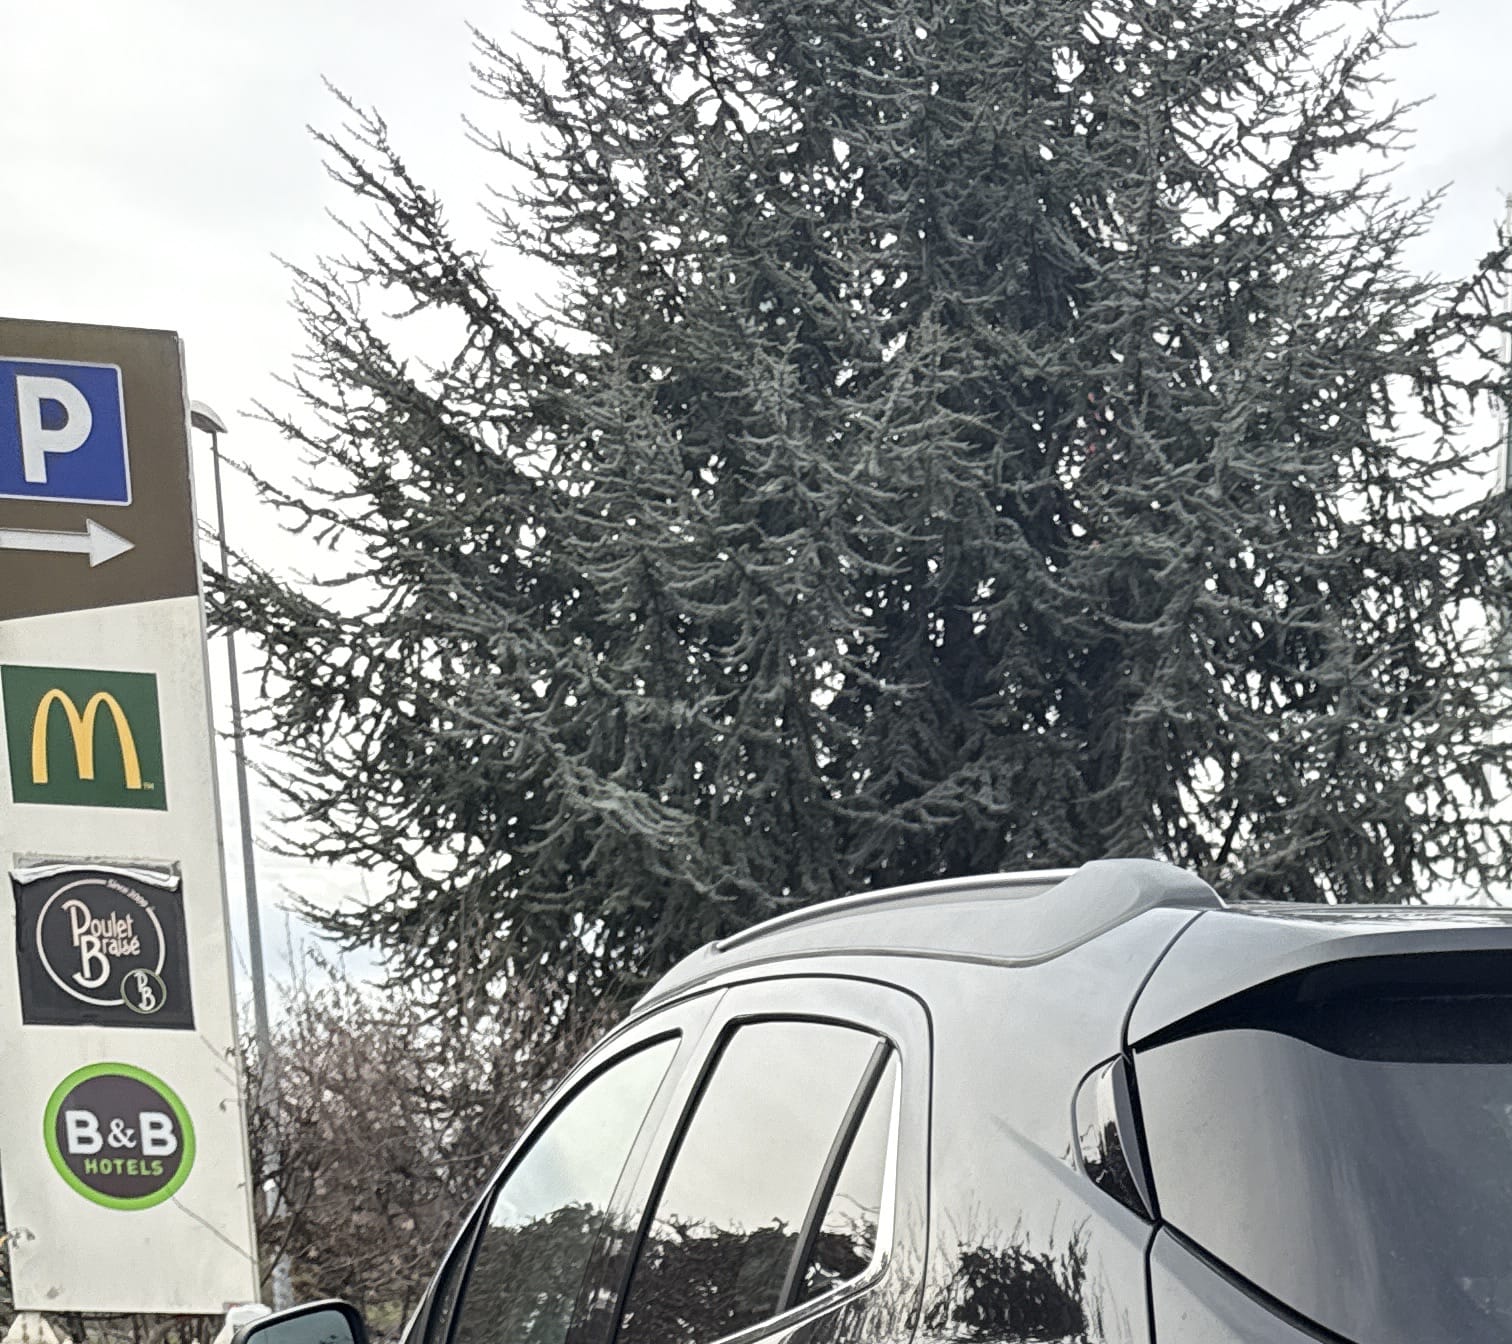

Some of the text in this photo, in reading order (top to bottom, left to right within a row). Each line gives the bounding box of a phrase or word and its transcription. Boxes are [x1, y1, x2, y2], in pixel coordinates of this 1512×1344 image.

[15, 374, 93, 484] P
[61, 899, 134, 947] Poulet
[84, 1157, 164, 1176] HOTELS
